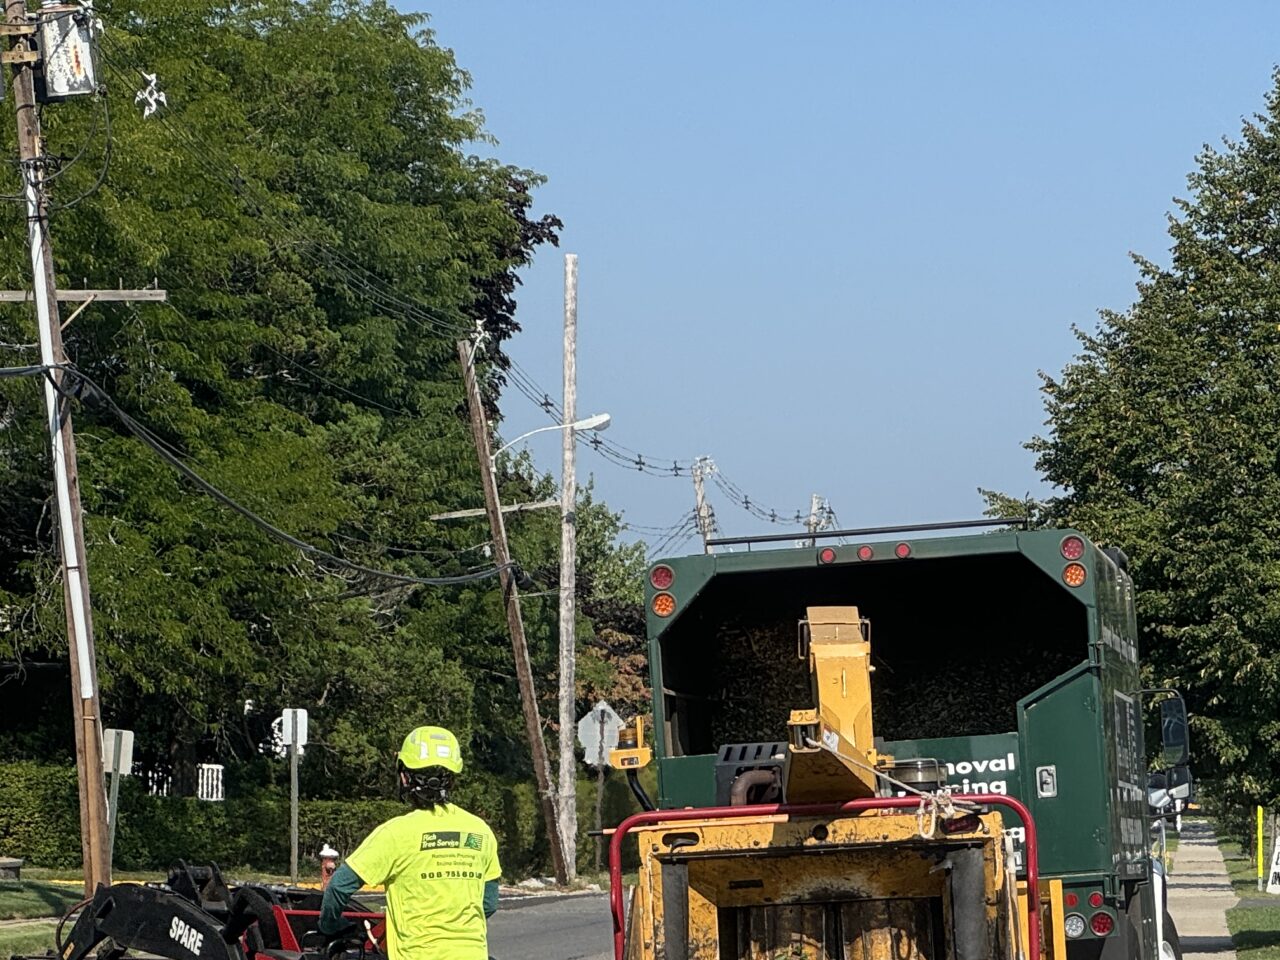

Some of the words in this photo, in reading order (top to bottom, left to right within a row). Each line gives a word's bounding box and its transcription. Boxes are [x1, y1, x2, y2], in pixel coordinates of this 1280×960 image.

[945, 753, 1015, 775] oval
[422, 841, 436, 849] Tree
[437, 839, 459, 848] Service
[423, 833, 437, 842] Rich
[169, 915, 205, 957] SPARE
